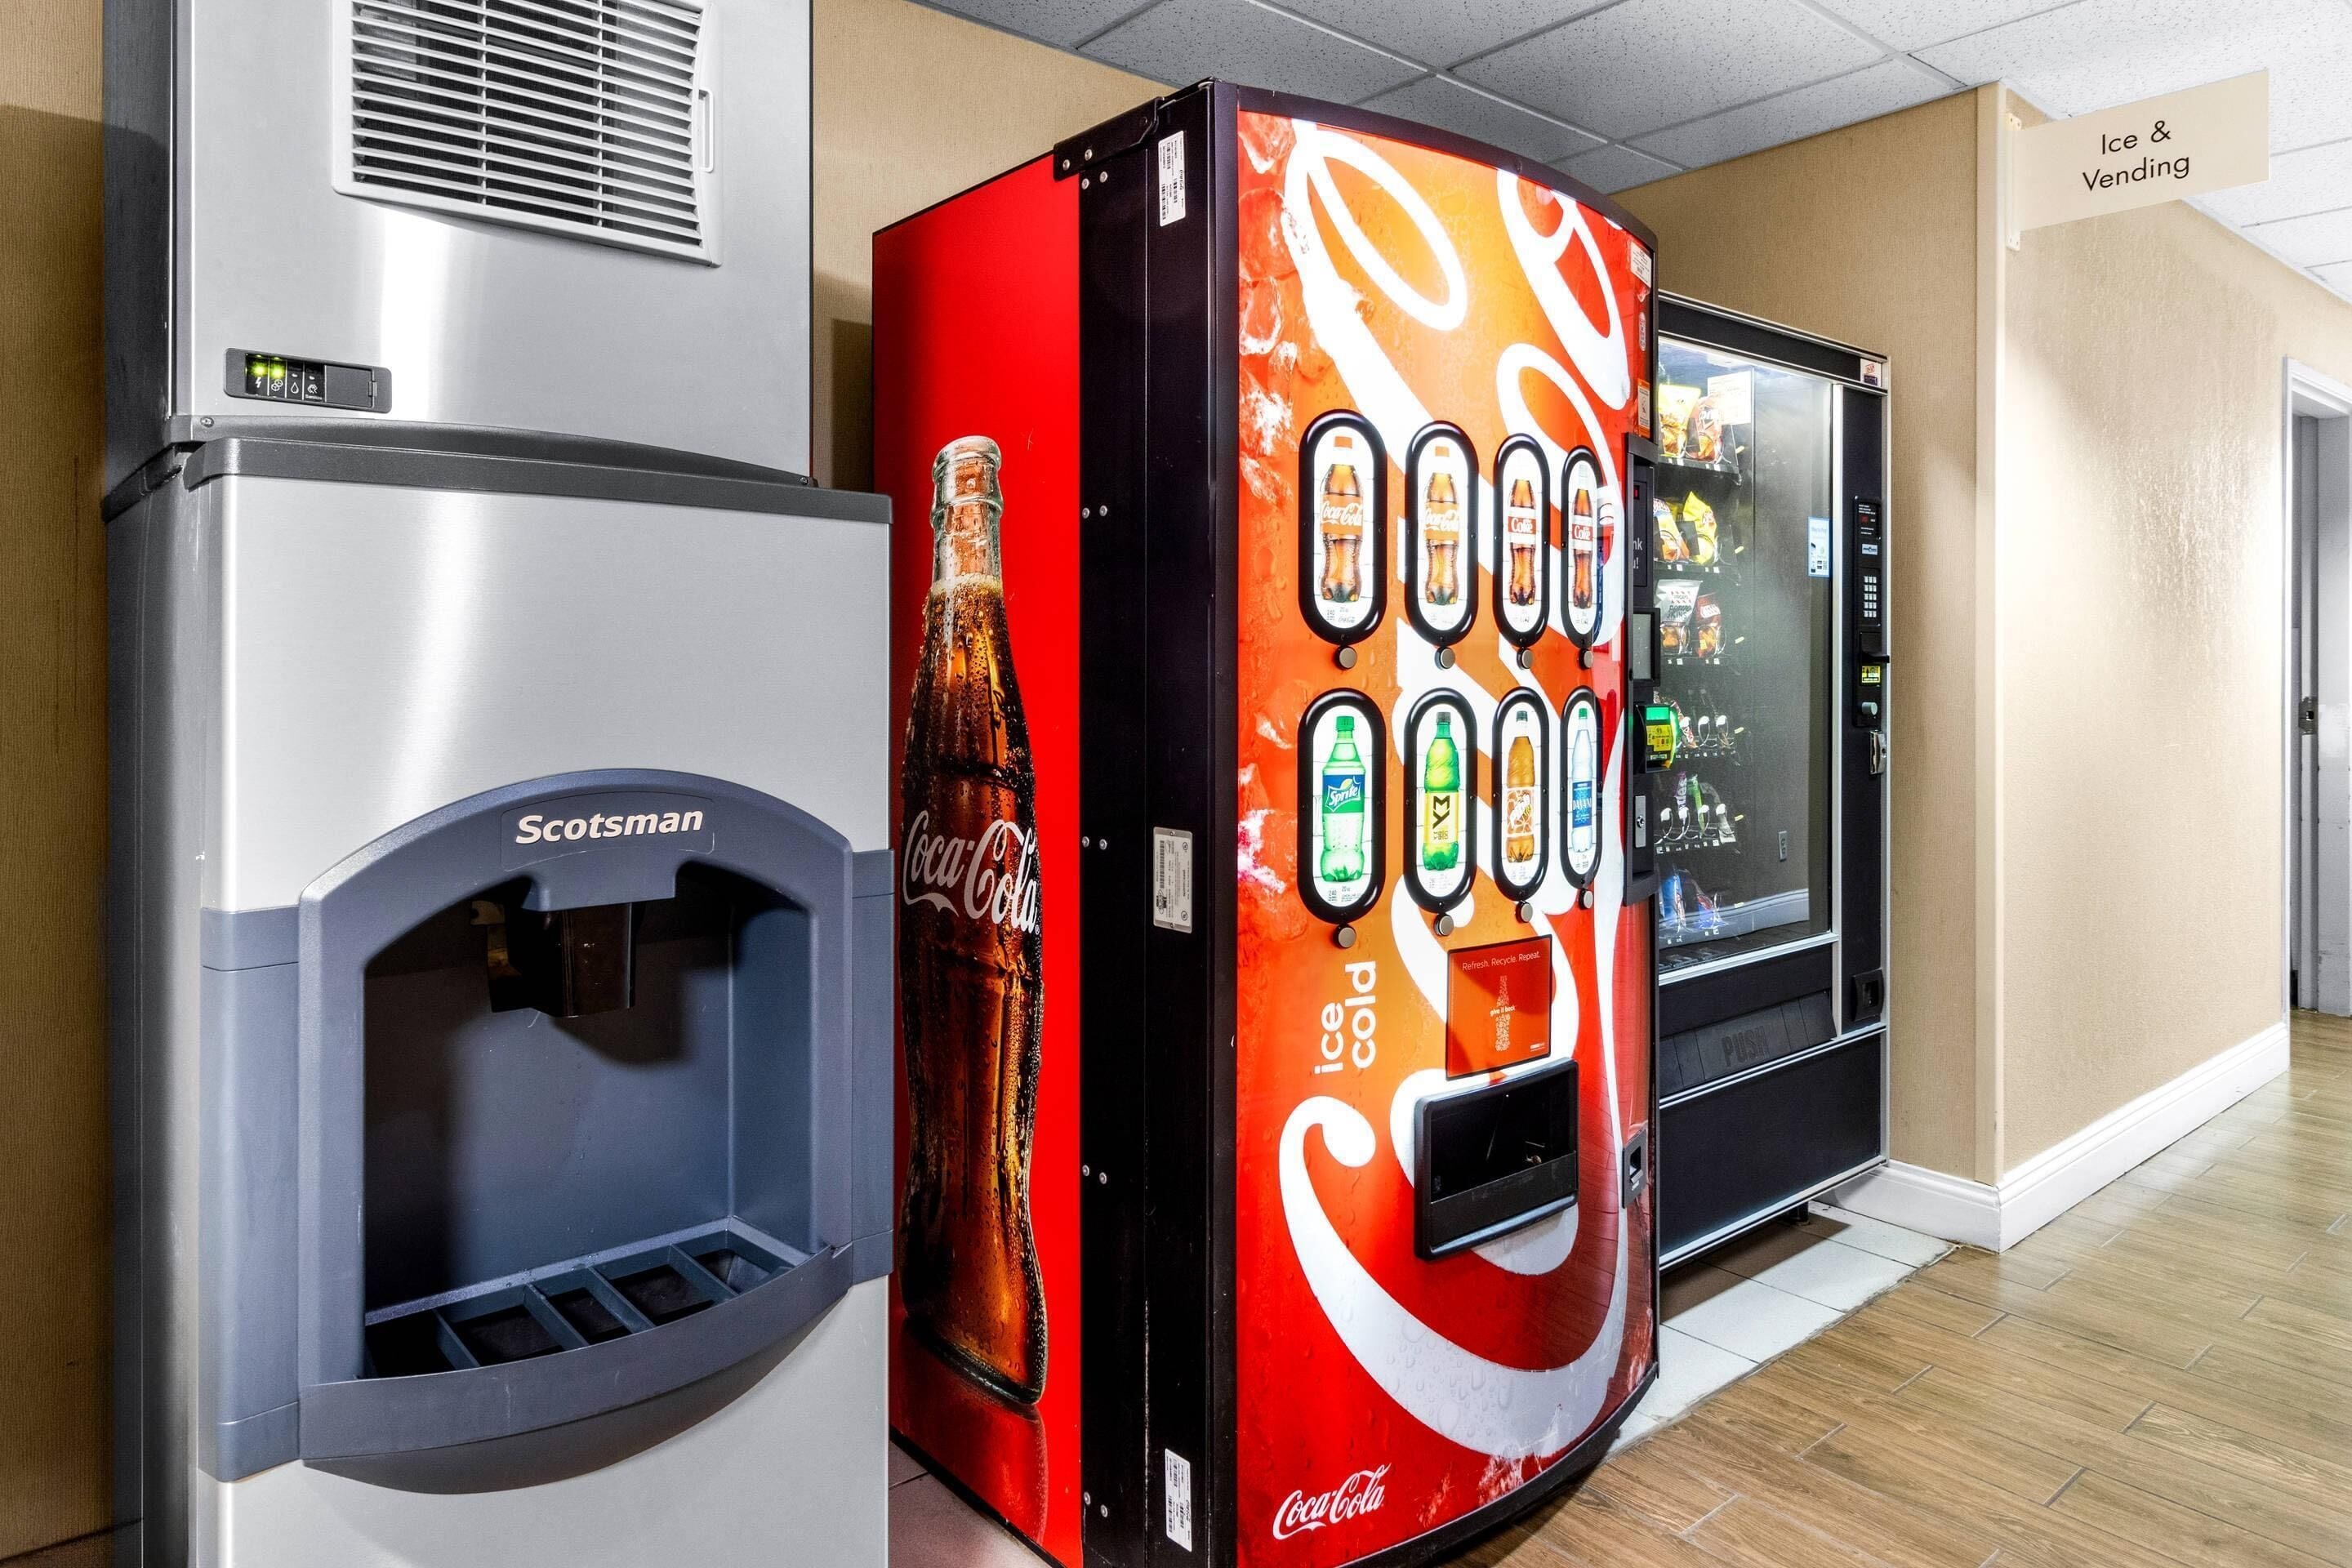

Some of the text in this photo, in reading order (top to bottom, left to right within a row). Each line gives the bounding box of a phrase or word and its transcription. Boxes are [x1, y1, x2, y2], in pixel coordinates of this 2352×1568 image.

[2101, 120, 2172, 155] Ice &
[2082, 156, 2190, 192] Vending
[1329, 783, 1358, 807] Sprite
[515, 809, 704, 844] Scotsman
[902, 809, 1037, 933] Coca-Cola
[1462, 951, 1541, 971] Refresh. Recycle. Repeat.
[1344, 960, 1377, 1070] cold
[1313, 1002, 1344, 1076] ice
[1721, 1025, 1771, 1067] PUSH
[1272, 1462, 1392, 1540] Coca-Cola
